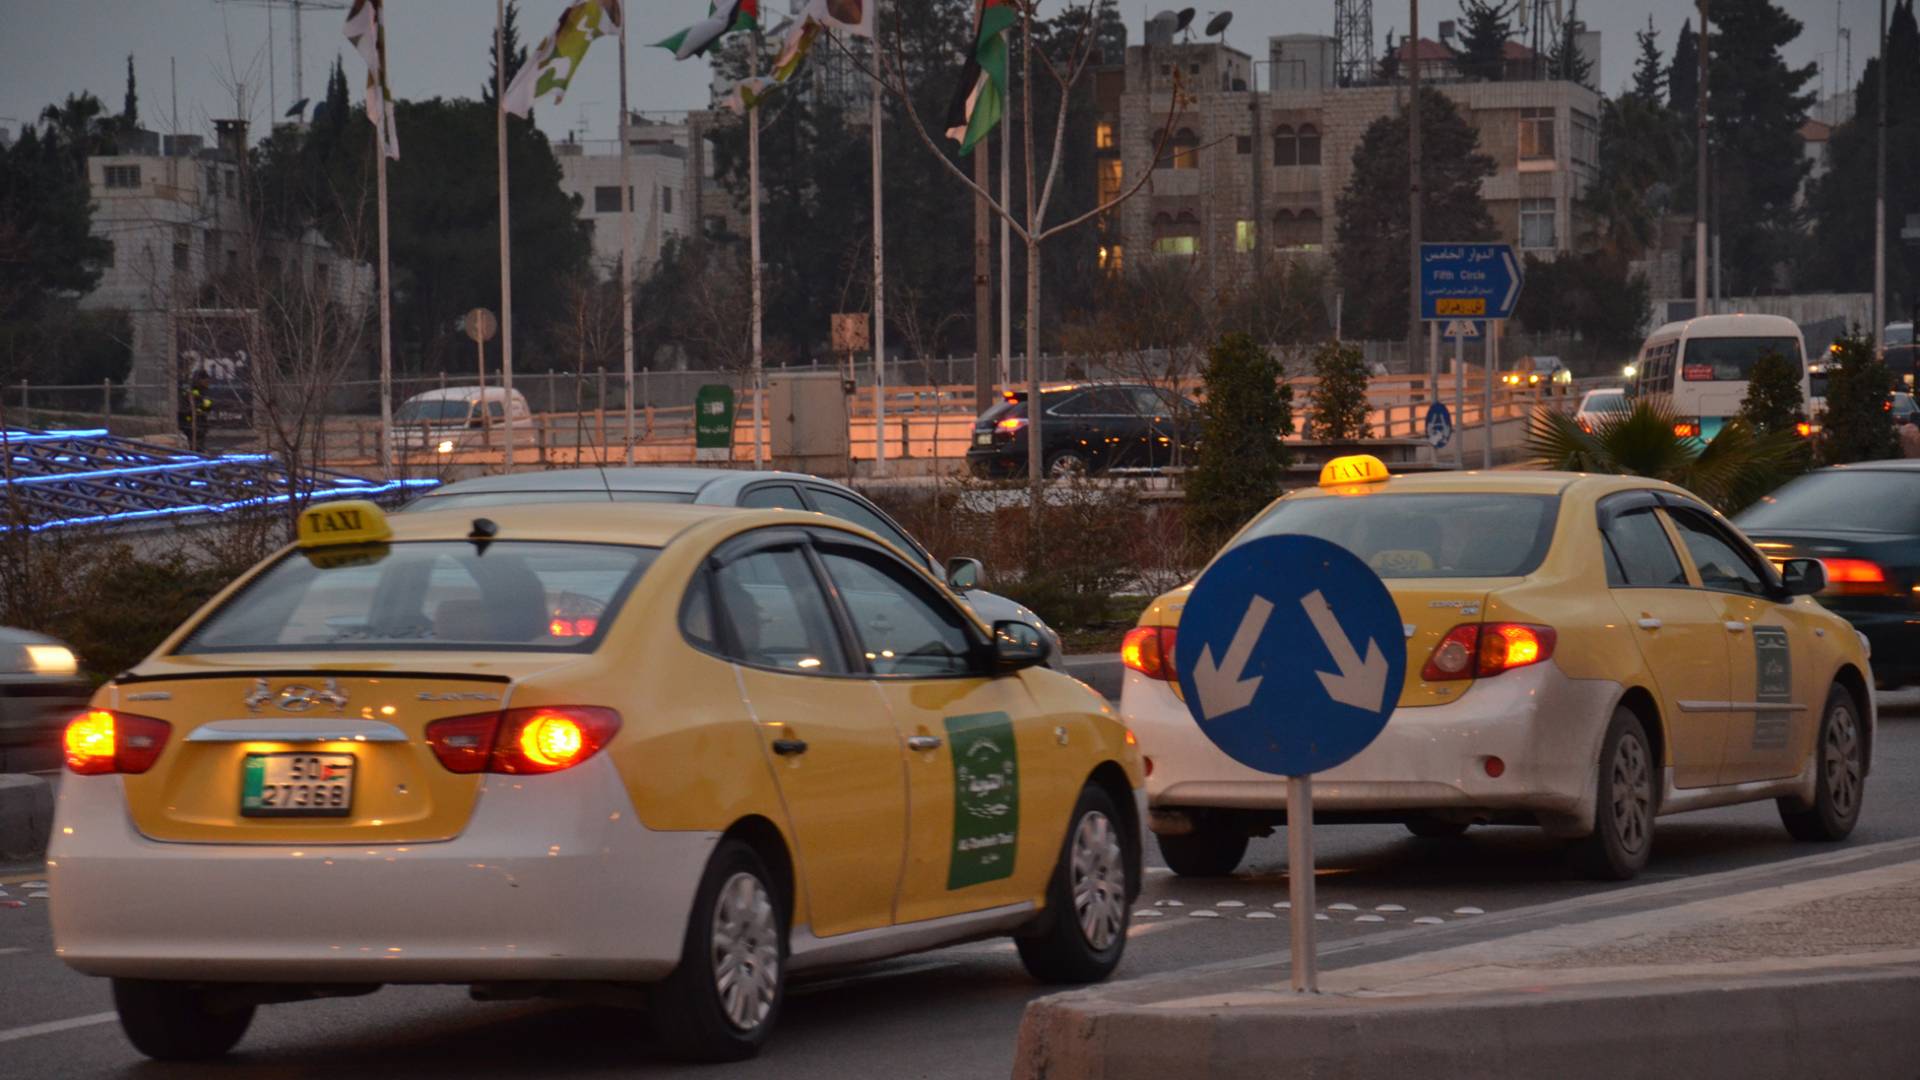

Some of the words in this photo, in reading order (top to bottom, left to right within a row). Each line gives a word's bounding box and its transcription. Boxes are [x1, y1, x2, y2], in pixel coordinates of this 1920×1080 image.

[1467, 248, 1495, 262] الدوار
[1433, 270, 1455, 281] Fifth
[1460, 270, 1486, 281] Circle
[1328, 461, 1371, 480] TAXI
[307, 510, 363, 533] TAXI
[291, 757, 320, 780] 50
